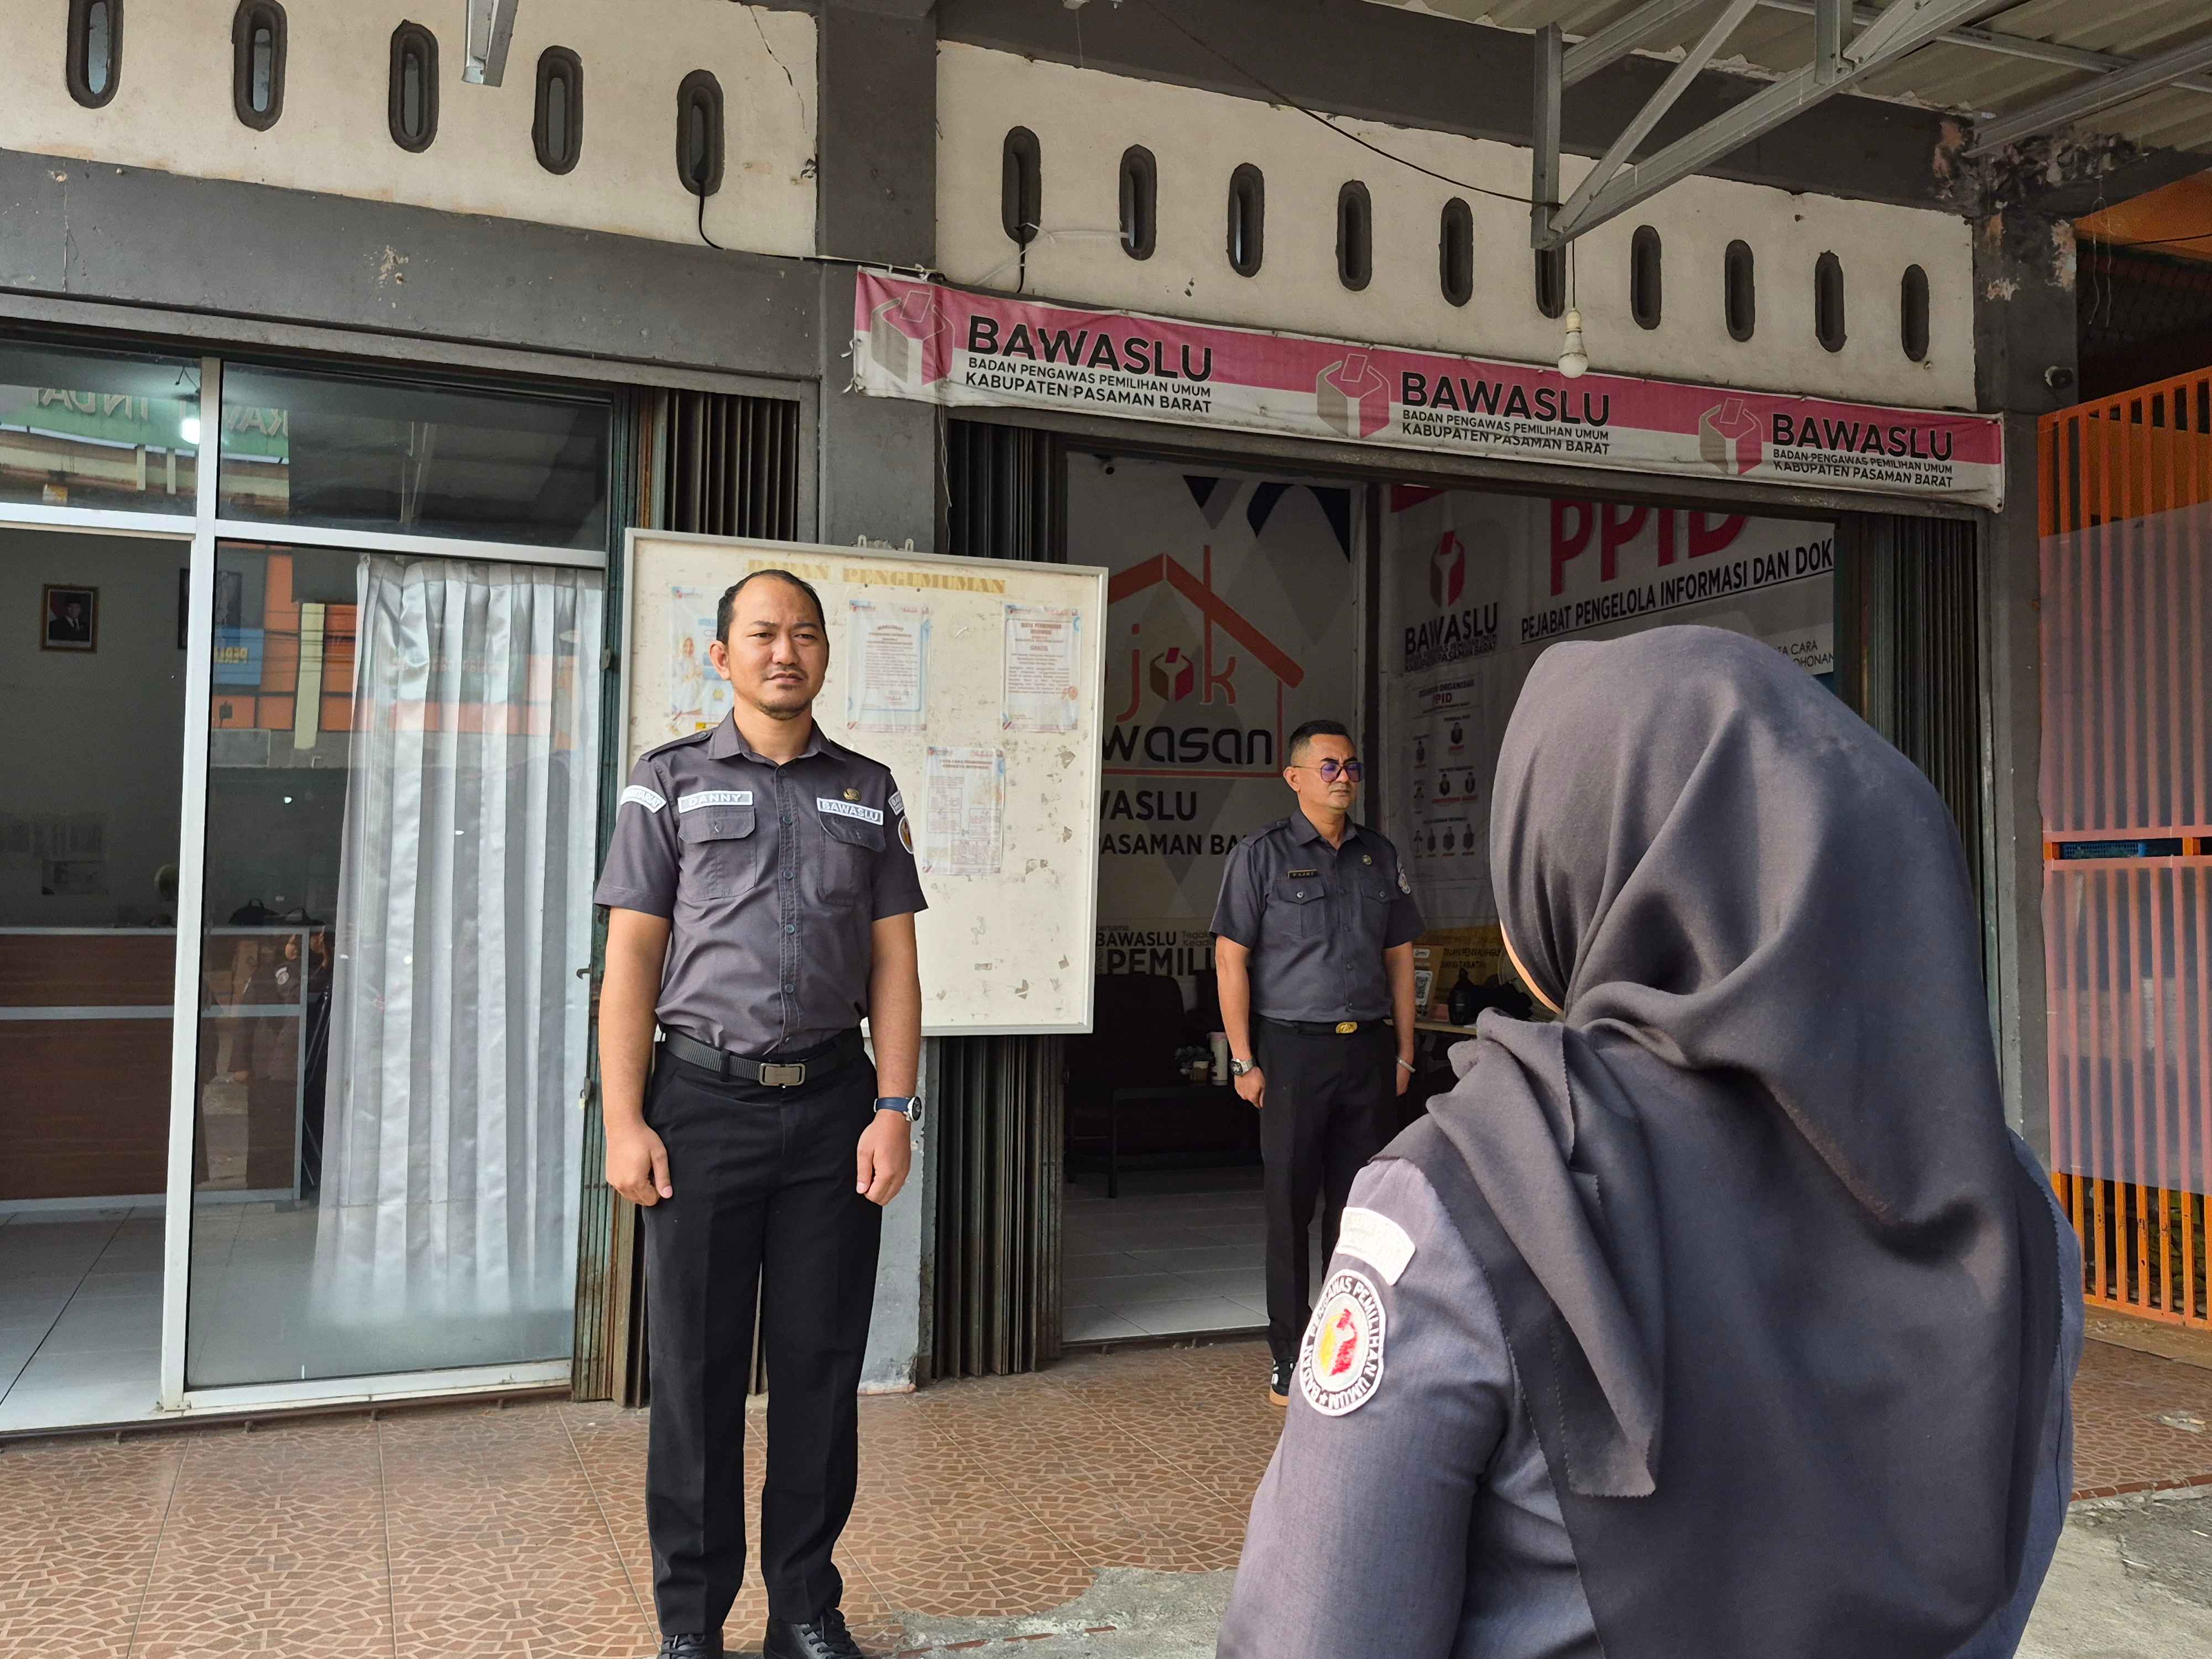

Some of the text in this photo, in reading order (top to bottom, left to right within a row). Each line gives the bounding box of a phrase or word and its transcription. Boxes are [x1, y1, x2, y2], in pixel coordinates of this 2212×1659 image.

[968, 315, 1212, 382] BAWASLU
[966, 372, 1212, 414] KABUPATEN PASAMAN BARAT
[969, 357, 1211, 398] BADAN PENGAWAS PEMILIHAN UMUM
[1402, 372, 1609, 427] BAWASLU
[1402, 422, 1610, 455] KABUPATEN PASAMAN BARAT
[1403, 410, 1608, 440] BADAN PENGAWAS PEMILIHAN UMUM
[1773, 414, 1952, 461] BAWASLU
[1773, 449, 1952, 474] BADAN PENGAWAS PEMILIHAN UMUM
[1773, 461, 1953, 488] KABUPATEN PASAMAN BARAT
[843, 568, 1006, 593] PENGUMUMAN
[1521, 538, 1833, 640] PEJABAT PENGELOLA INFORMASI DAN DOK
[1405, 602, 1498, 654] BAWASLU
[1791, 640, 1818, 655] CARA
[688, 794, 742, 806] DANNY
[822, 801, 878, 821] BAWASLU
[1099, 833, 1245, 855] ASAMAN BA
[1096, 931, 1176, 946] BAWASLU
[1309, 1276, 1379, 1377] PENGAWAS PEMILIHAN
[1302, 1344, 1321, 1400] BADAN
[1328, 1376, 1371, 1410] UMUM
